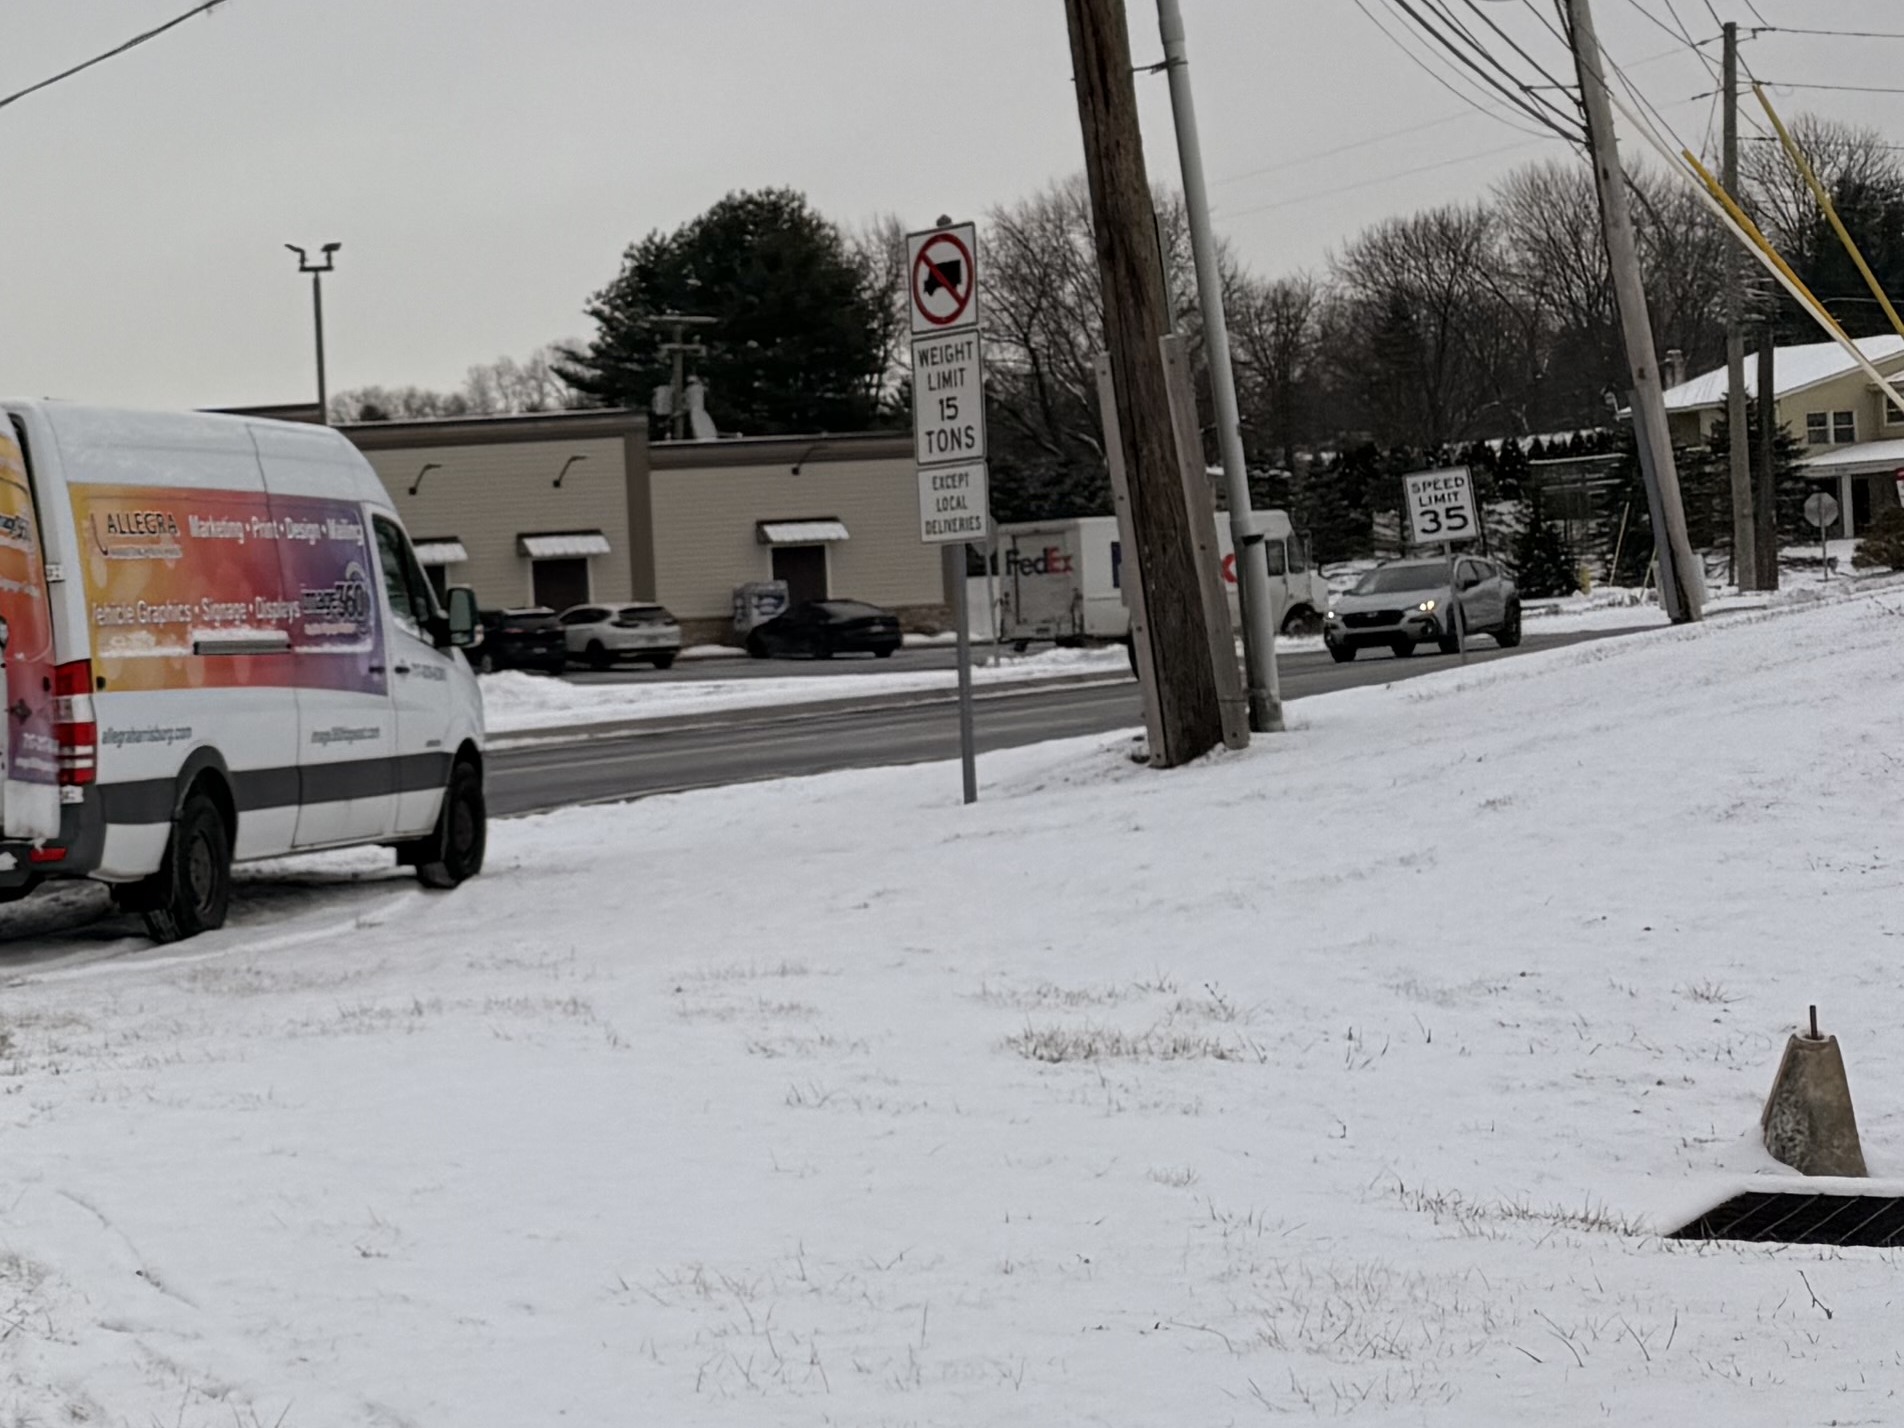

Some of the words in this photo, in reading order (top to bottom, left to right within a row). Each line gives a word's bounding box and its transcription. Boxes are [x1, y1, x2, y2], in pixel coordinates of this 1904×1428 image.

[918, 341, 974, 368] WEIGHT
[928, 367, 967, 392] LIMIT
[939, 396, 959, 422] 15
[925, 425, 976, 454] TONS
[932, 472, 970, 491] EXCEPT
[1411, 476, 1465, 494] SPEED
[936, 494, 969, 512] LOCAL
[1419, 491, 1460, 508] LIMIT
[107, 513, 178, 535] ALLEGRA
[925, 515, 982, 536] DELIVERIES
[1419, 505, 1469, 534] 35
[1005, 546, 1074, 577] FedEx
